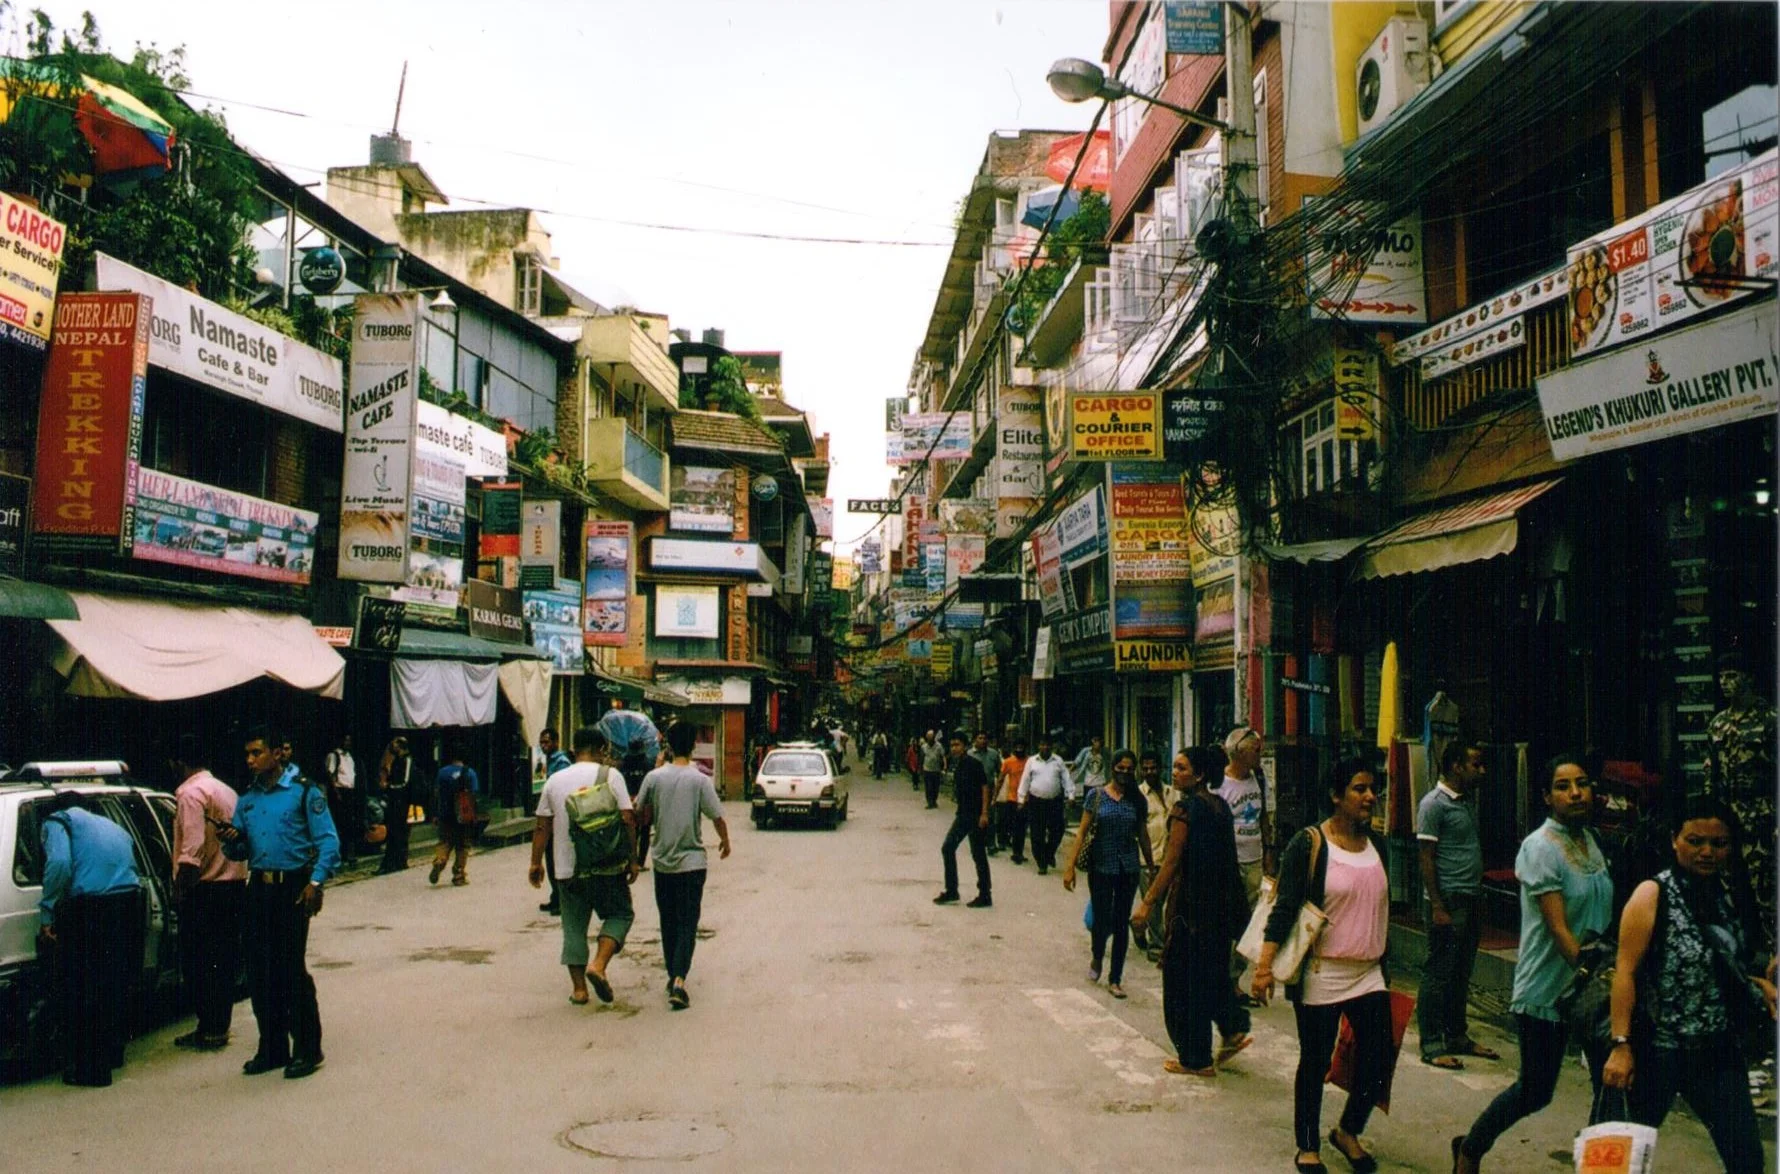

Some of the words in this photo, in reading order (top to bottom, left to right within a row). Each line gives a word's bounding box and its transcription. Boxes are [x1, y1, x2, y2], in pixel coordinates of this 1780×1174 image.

[6, 203, 62, 254] CARGO
[13, 240, 57, 275] Service)
[1613, 238, 1645, 269] $1.40
[300, 263, 339, 282] Carlsberg
[102, 303, 135, 328] LAND
[54, 331, 127, 346] NEPAL
[190, 305, 278, 367] Namaste
[365, 323, 412, 338] TUBORG
[198, 348, 229, 371] Cafe
[233, 362, 244, 376] &
[248, 367, 269, 386] Bar
[299, 375, 341, 408] TUBORG
[349, 369, 409, 416] NAMASTE
[1547, 403, 1604, 441] LEGEND'S
[1603, 387, 1666, 427] KHUKURI
[1667, 367, 1733, 411] GALLERY
[1734, 357, 1774, 393] PVT.
[1075, 398, 1153, 413] CARGO
[362, 400, 393, 431] CAFE
[1110, 412, 1120, 423] &
[57, 349, 105, 520] TREKKING
[418, 423, 450, 448] maste
[1075, 423, 1153, 433] COURIER
[129, 415, 142, 460] BHUTAN
[351, 437, 368, 446] Top
[370, 437, 407, 445] Terrace
[1002, 429, 1044, 446] Elite
[1086, 435, 1145, 447] OFFICE
[1105, 449, 1135, 457] FLOOR
[1012, 465, 1020, 473] &
[127, 461, 138, 505] TIBET
[1002, 474, 1029, 483] Bar
[345, 495, 370, 504] Live
[372, 496, 404, 504] Music
[850, 501, 900, 512] FACES
[1115, 530, 1189, 541] CARGO
[352, 545, 402, 559] TUBORG
[1115, 553, 1154, 561] LAUNDRY
[1136, 569, 1158, 578] MONEY
[472, 607, 501, 626] KARMA
[502, 612, 523, 630] GEMS
[1119, 645, 1193, 662] LAUNDRY
